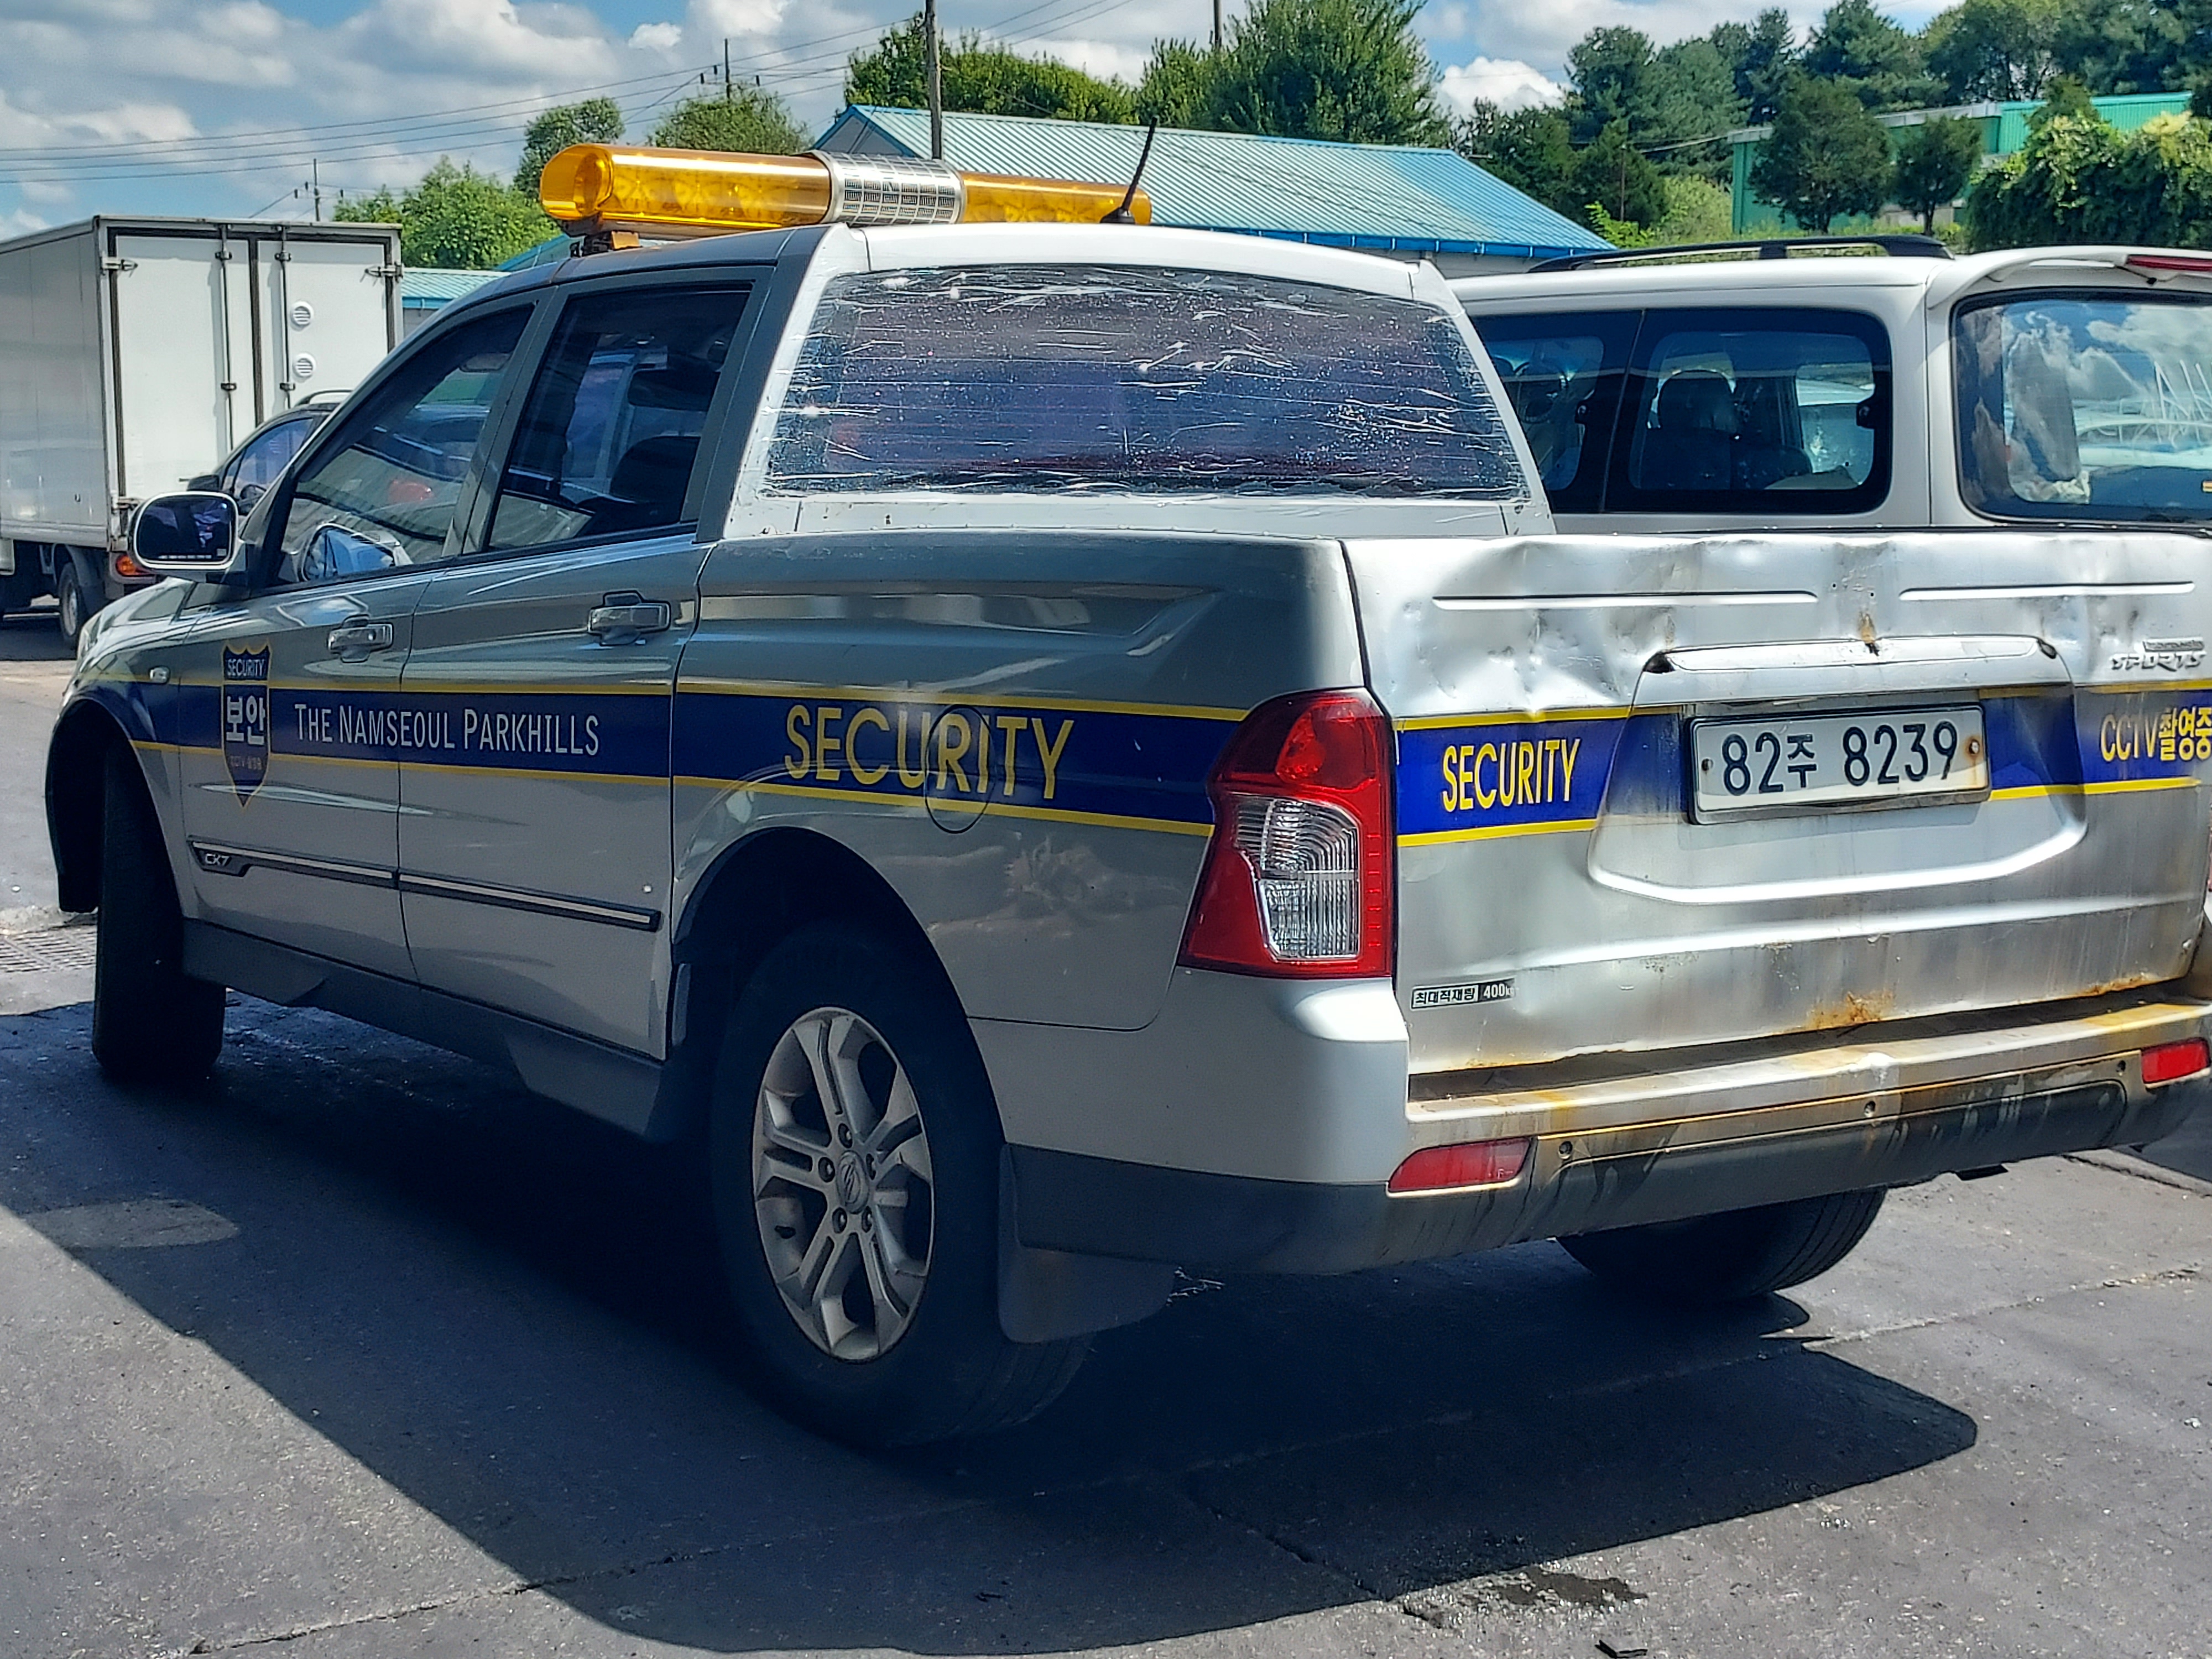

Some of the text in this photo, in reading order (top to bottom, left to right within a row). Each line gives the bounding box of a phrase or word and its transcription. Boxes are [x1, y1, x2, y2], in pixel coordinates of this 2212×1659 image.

[227, 659, 265, 676] SECURITY
[2110, 651, 2206, 671] SPORTS
[226, 695, 266, 745] 보안
[785, 705, 1074, 799] SECURITY
[1442, 739, 1580, 812] SECURITY
[1722, 721, 1958, 796] 82주 8239
[205, 853, 229, 867] CX7
